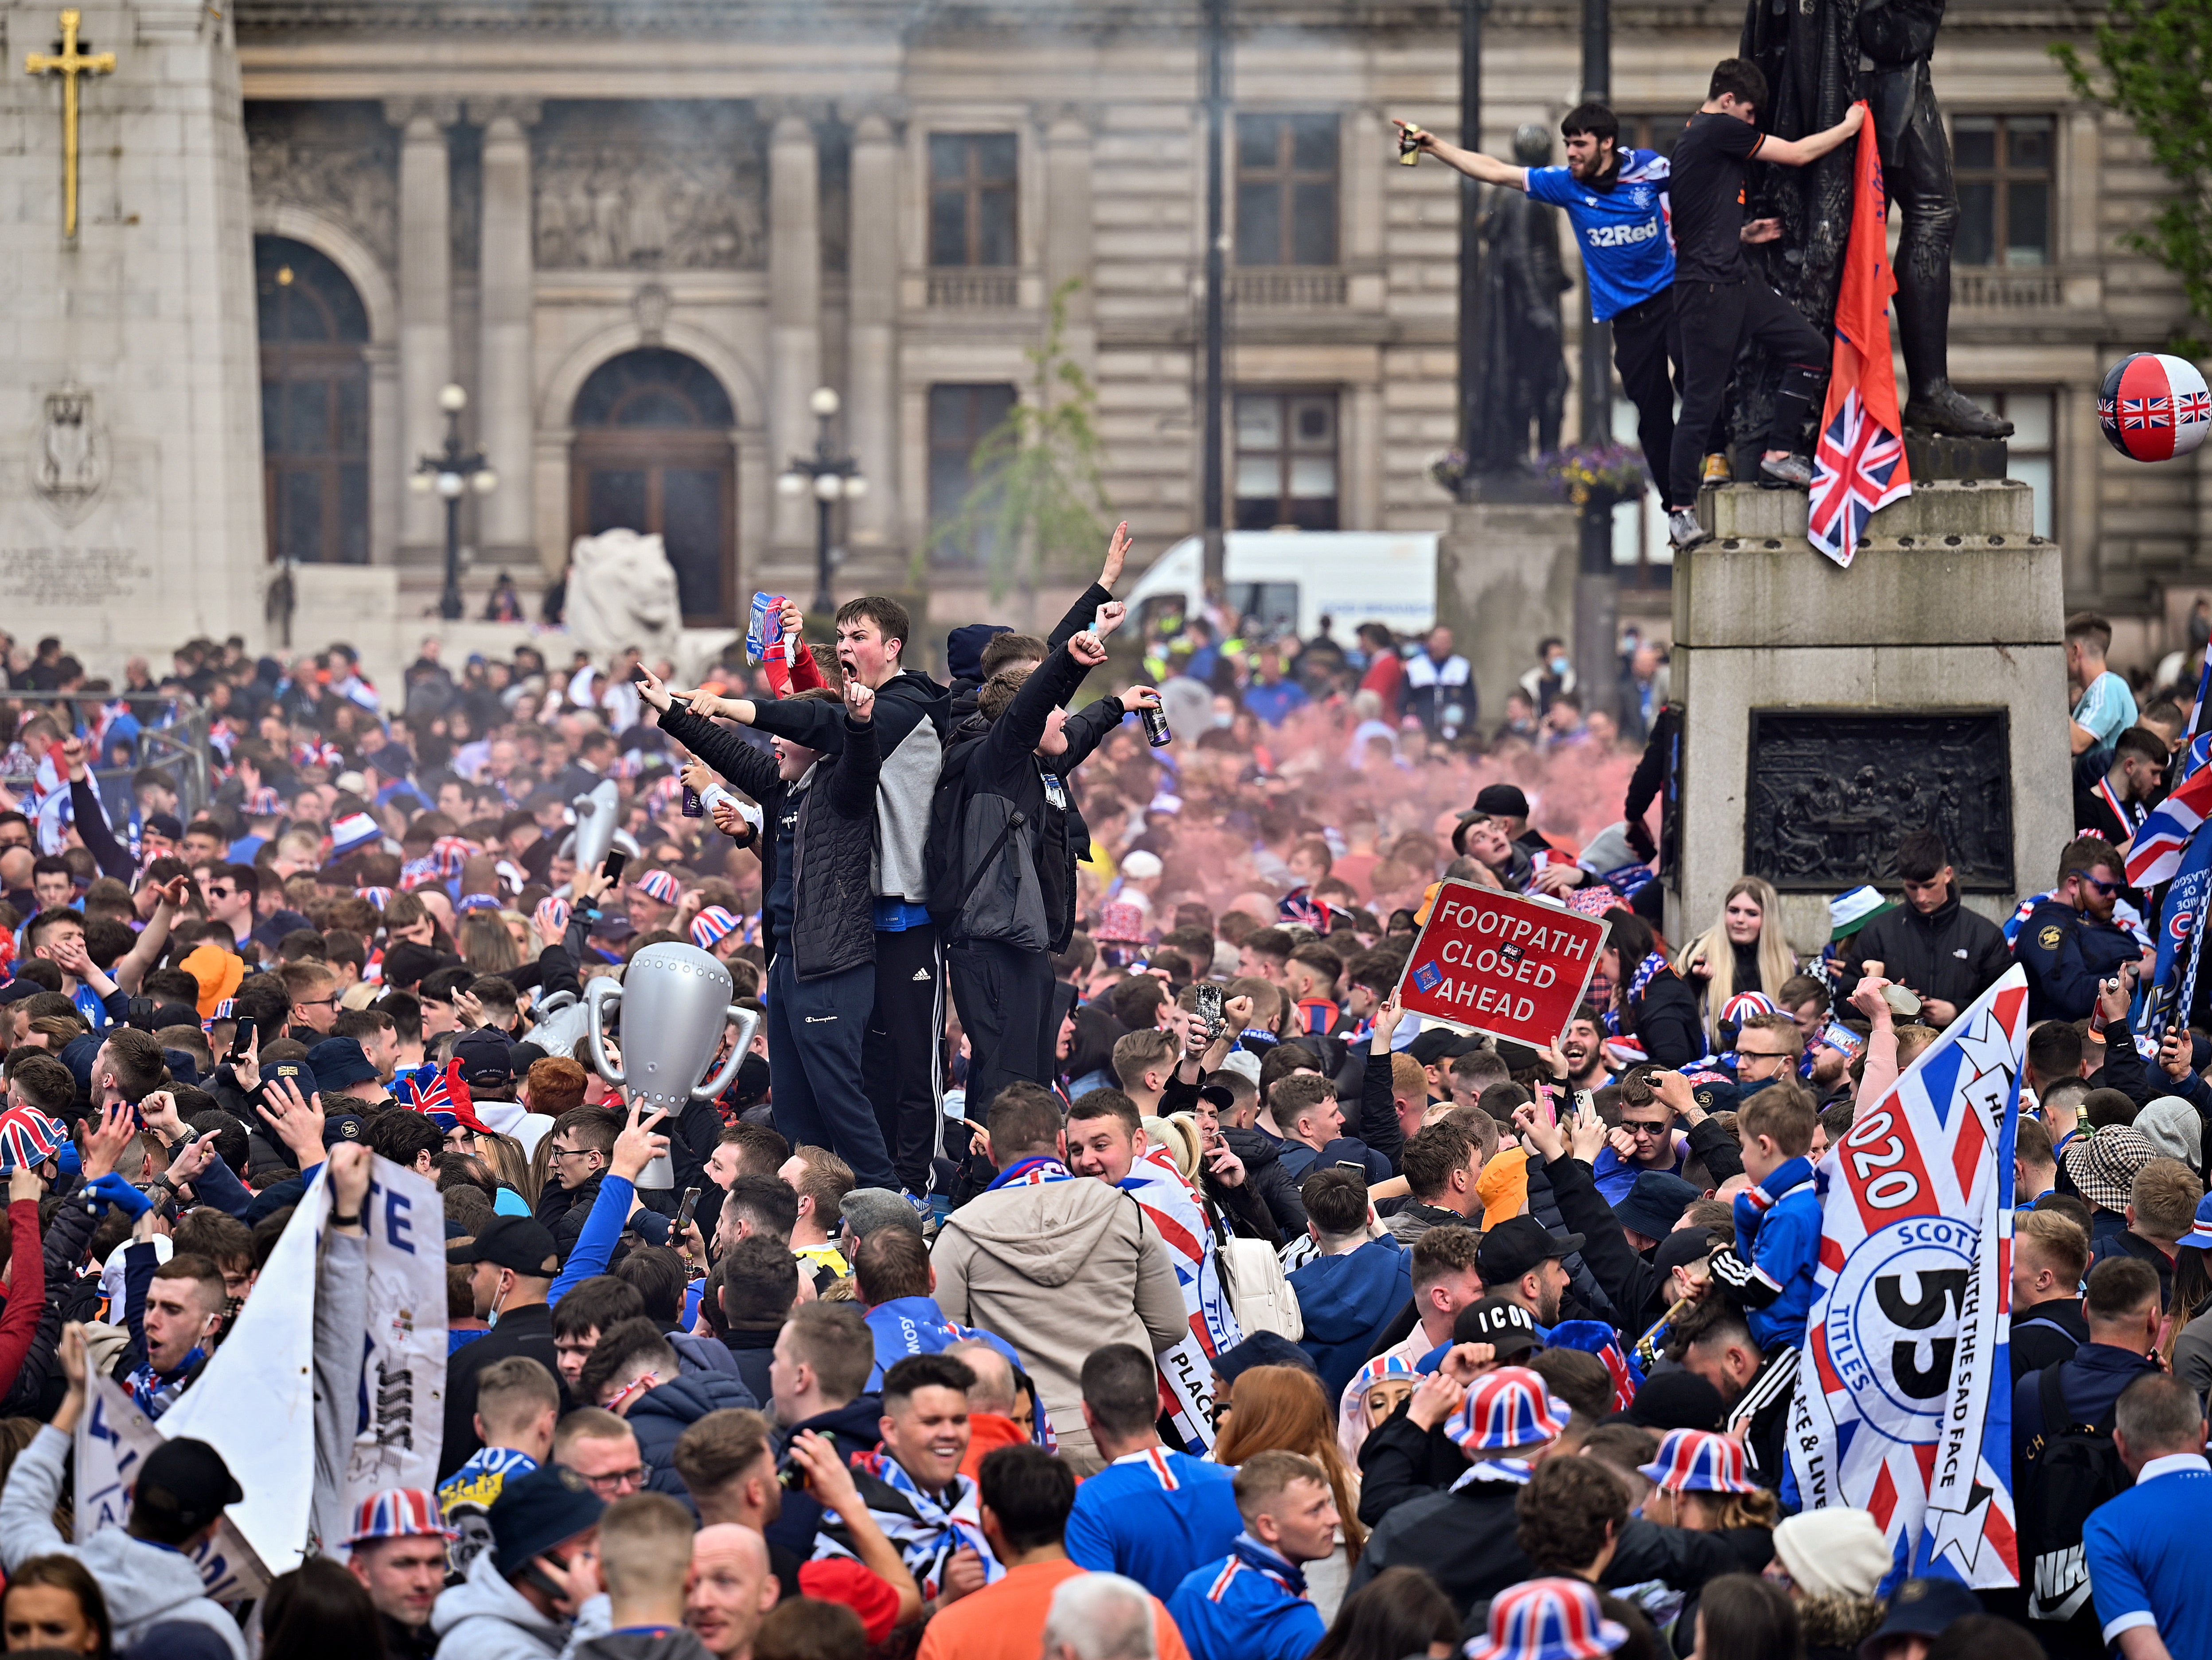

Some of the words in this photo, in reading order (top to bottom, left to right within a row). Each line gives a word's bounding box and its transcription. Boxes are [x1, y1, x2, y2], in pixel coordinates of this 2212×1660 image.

[1586, 216, 1658, 247] 32Red
[2177, 897, 2199, 911] RIDE
[2182, 885, 2196, 898] OF
[1440, 900, 1588, 961] FOOTPATH
[1442, 940, 1556, 988] CLOSED
[1434, 977, 1534, 1021] AHEAD
[1985, 1093, 2004, 1128] HE
[1847, 1111, 1919, 1210] 020
[1965, 1254, 1981, 1317] WITH
[1479, 1305, 1533, 1333] ICON
[1959, 1318, 1978, 1368] THE
[1831, 1304, 1869, 1391] TITLES
[1170, 1352, 1213, 1424] PLACE
[1954, 1372, 1971, 1421] SAD
[1800, 1435, 1818, 1453] &
[1940, 1427, 1965, 1488] FACE
[2034, 1541, 2089, 1601] NIK
